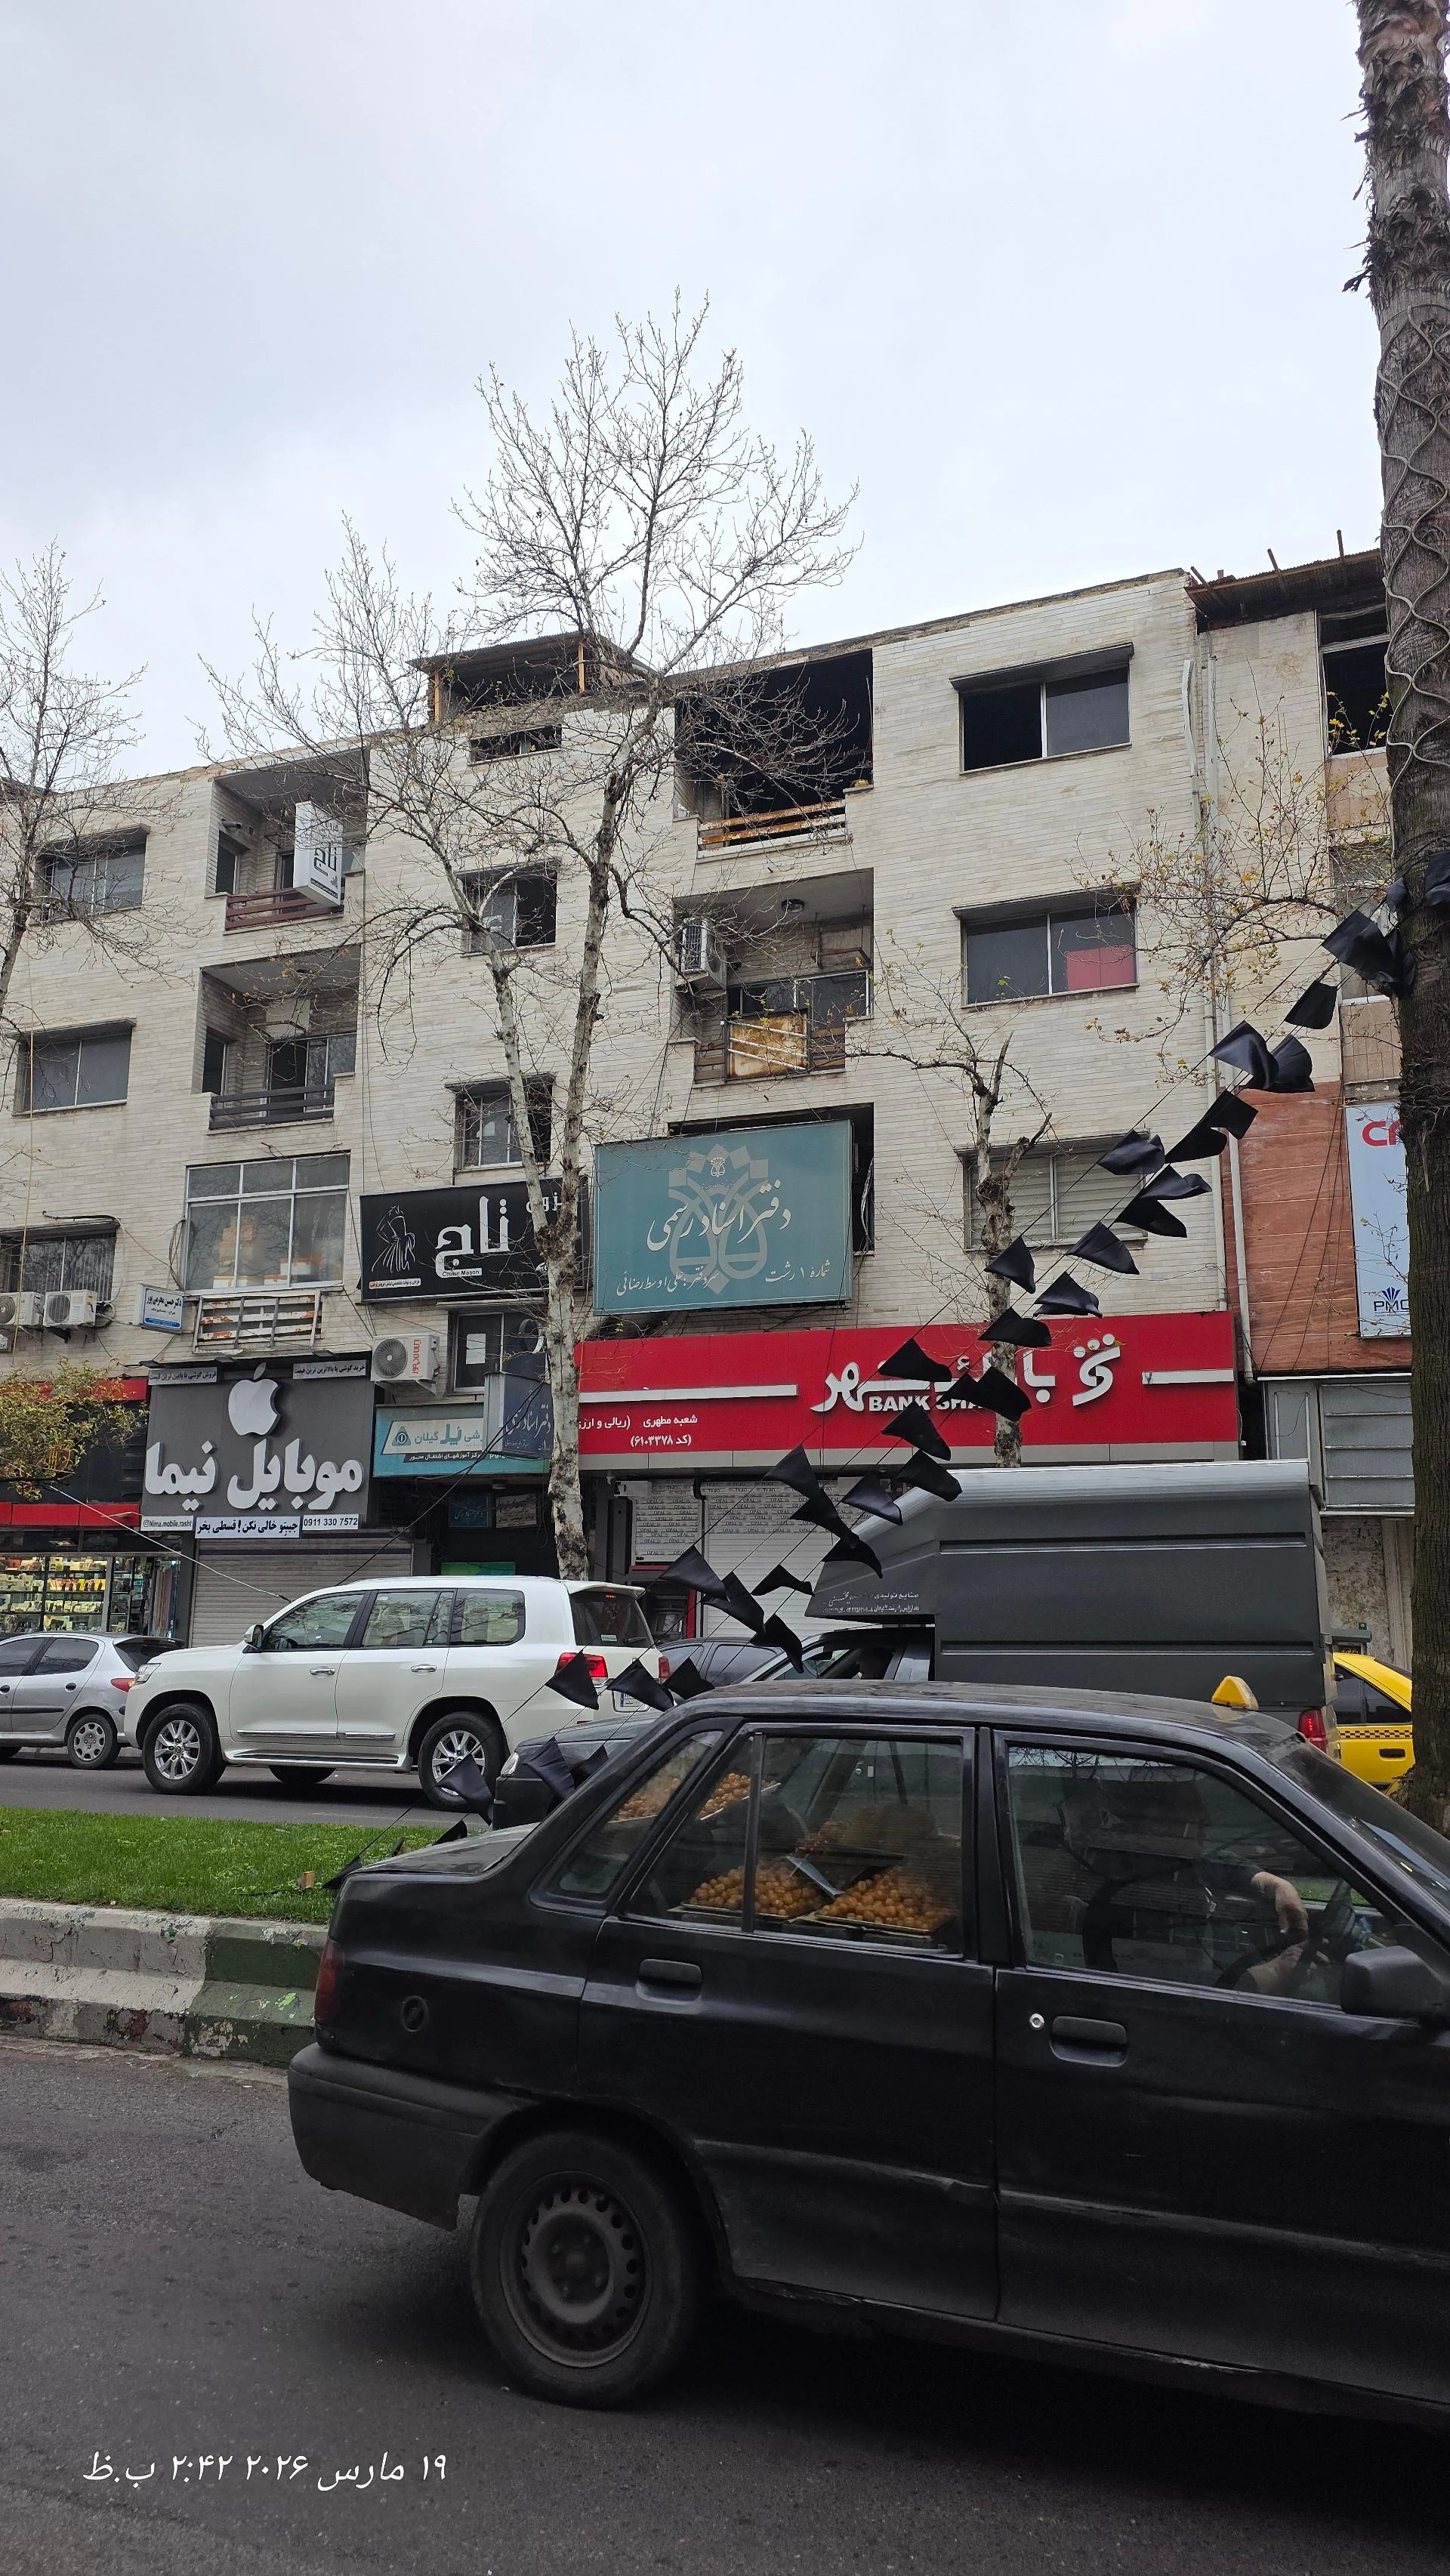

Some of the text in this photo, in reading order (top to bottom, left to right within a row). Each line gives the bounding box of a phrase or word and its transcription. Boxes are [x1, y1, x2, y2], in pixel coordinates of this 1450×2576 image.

[646, 1179, 791, 1251] دفتر اسناد رسمی
[435, 1195, 511, 1278] تاج
[765, 1260, 795, 1282] رشت
[801, 1266, 804, 1279] ۱
[667, 1271, 683, 1293] علی
[174, 1297, 182, 1309] دکتر
[202, 1371, 217, 1379] فروش
[339, 1365, 353, 1373] گوشی
[353, 1364, 366, 1372] خرید
[869, 1395, 930, 1411] BANK
[534, 1403, 551, 1439] دفتر
[597, 1421, 602, 1429] و
[643, 1416, 671, 1428] مطهری
[673, 1414, 698, 1427] شعبه
[415, 1430, 439, 1444] گیلان
[145, 1438, 362, 1510] موبایل نیما
[150, 1519, 192, 1528] Nima.mobile.rasht
[196, 1520, 211, 1535] بخر
[212, 1519, 236, 1534] قسطی
[258, 1519, 277, 1534] خالی
[304, 1517, 358, 1526] 0911 330 7572
